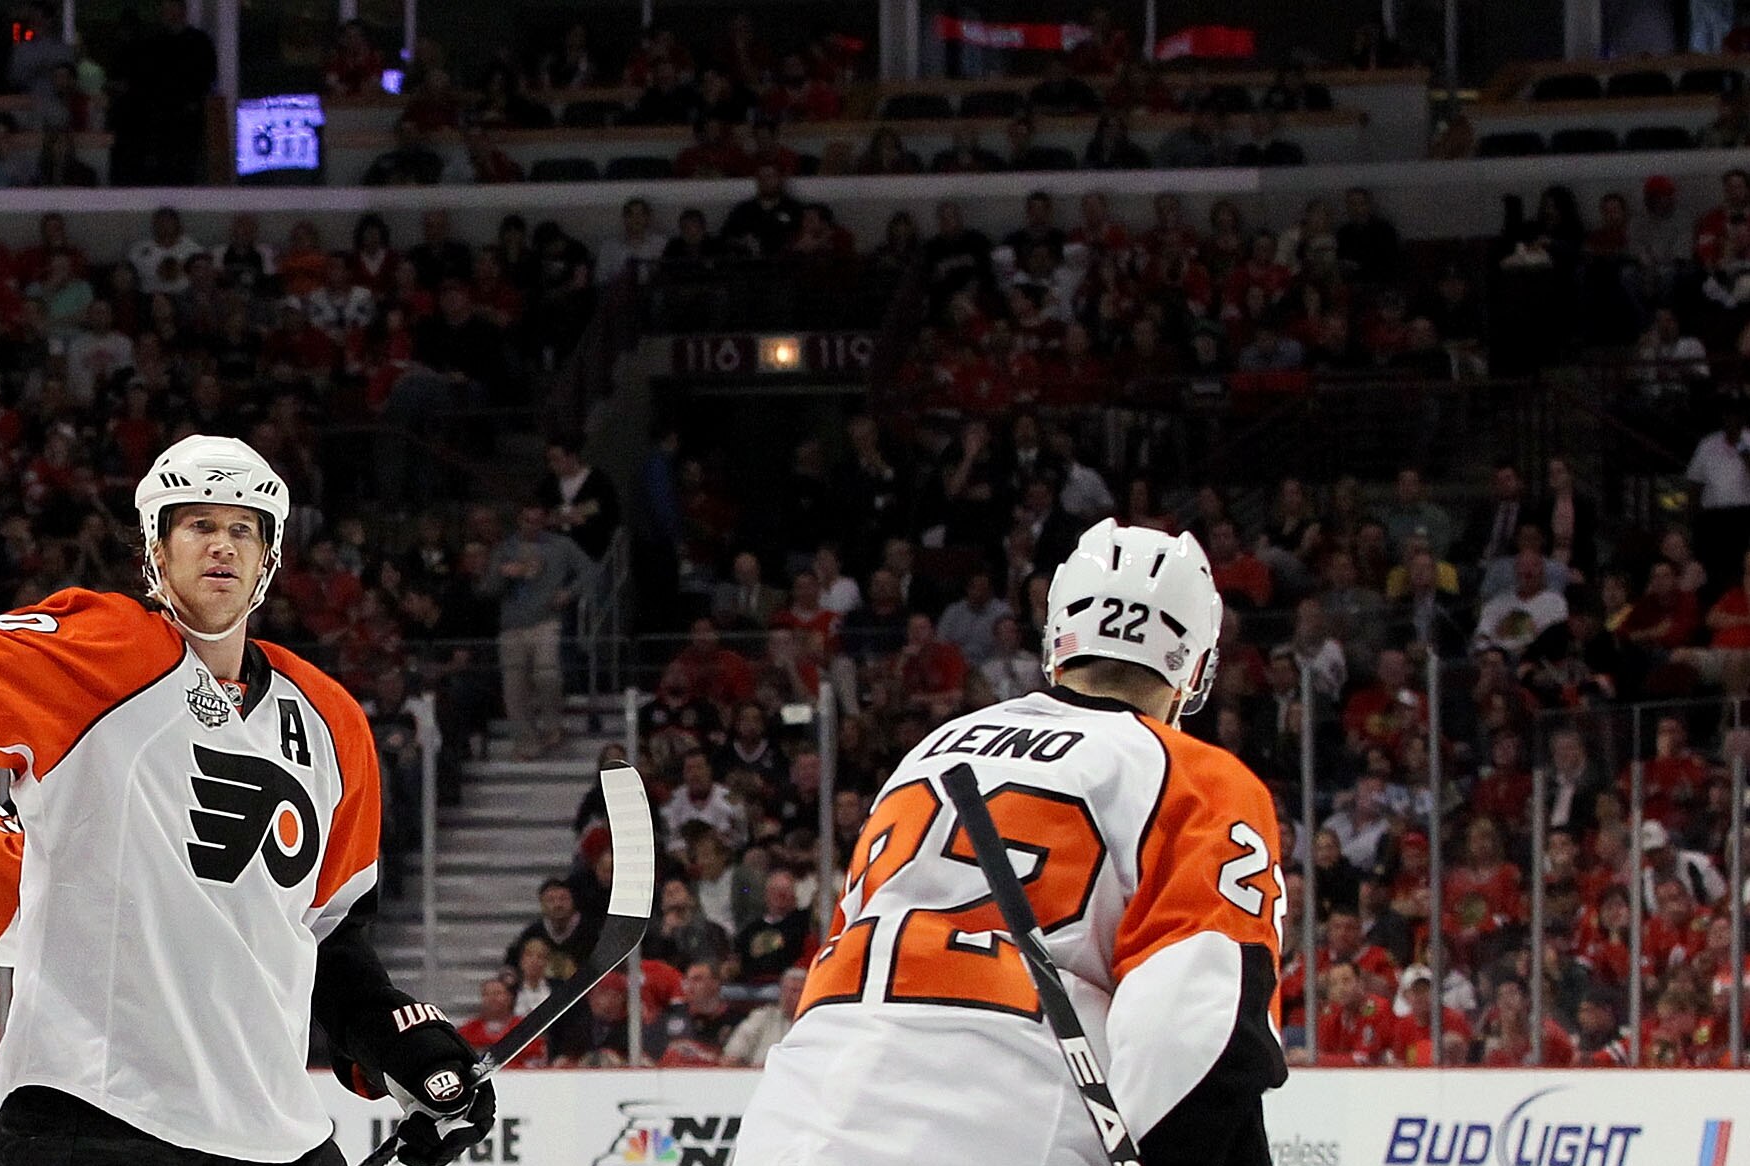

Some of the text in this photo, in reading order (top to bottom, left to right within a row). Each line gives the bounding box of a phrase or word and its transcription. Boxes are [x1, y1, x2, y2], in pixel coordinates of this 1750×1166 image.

[1098, 597, 1149, 645] 22
[189, 690, 230, 713] FINAL
[276, 698, 312, 768] A
[918, 724, 1085, 763] LEINO
